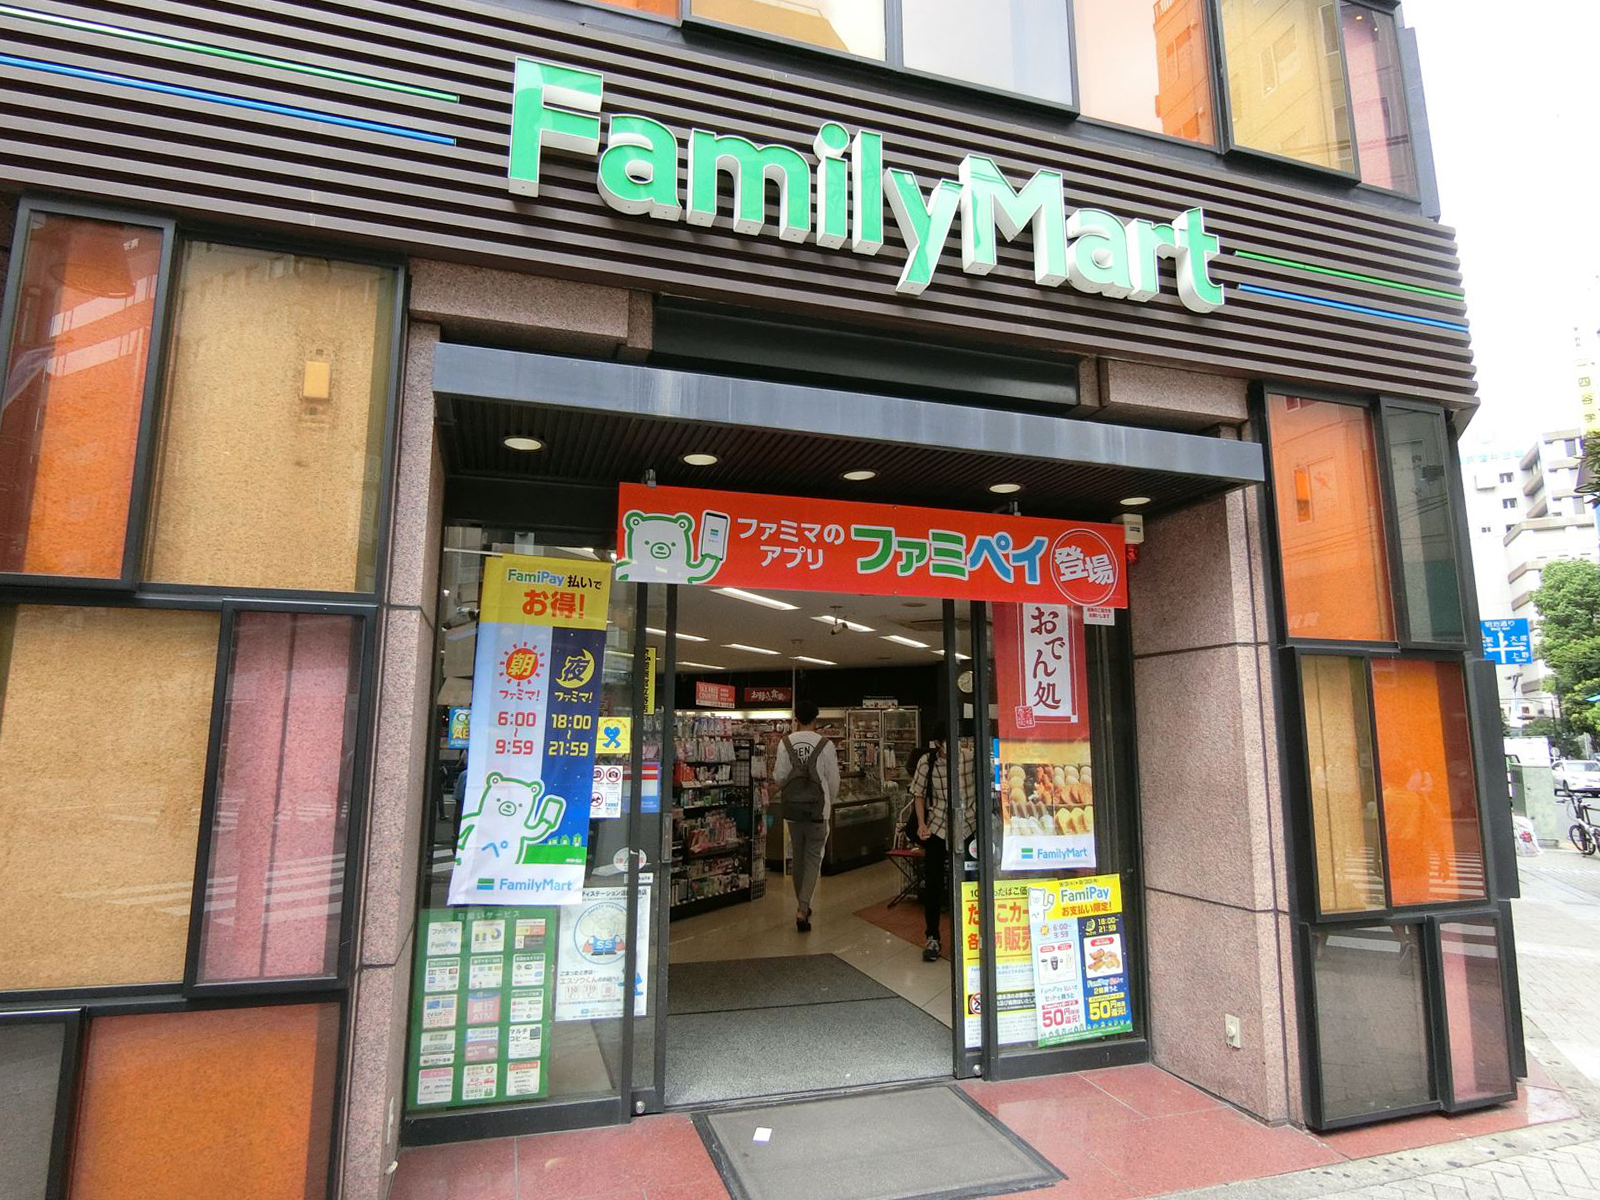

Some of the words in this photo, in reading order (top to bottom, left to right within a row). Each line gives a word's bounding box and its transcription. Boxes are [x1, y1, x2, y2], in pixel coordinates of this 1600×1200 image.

[508, 56, 1225, 313] FamilyMart
[737, 517, 845, 545] ファミマの
[760, 545, 823, 570] アプリ
[851, 525, 1048, 585] ファミペイ
[1054, 545, 1114, 585] 登場
[507, 568, 564, 586] FamiPay
[567, 574, 602, 589] 払いで
[522, 589, 585, 621] お得!
[507, 652, 537, 676] 朝
[1030, 606, 1066, 710] おでん処
[560, 656, 591, 683] 夜
[499, 688, 540, 701] ファミマ!
[554, 690, 593, 703] ファミマ!
[498, 711, 537, 727] 6:00
[551, 713, 592, 729] 18:00
[495, 739, 533, 755] 9:59
[548, 741, 589, 756] 21:59
[1037, 848, 1087, 860] FamilyMart
[499, 878, 572, 892] FamilyMart
[1060, 886, 1109, 902] FamiPay
[1042, 1009, 1064, 1028] 50
